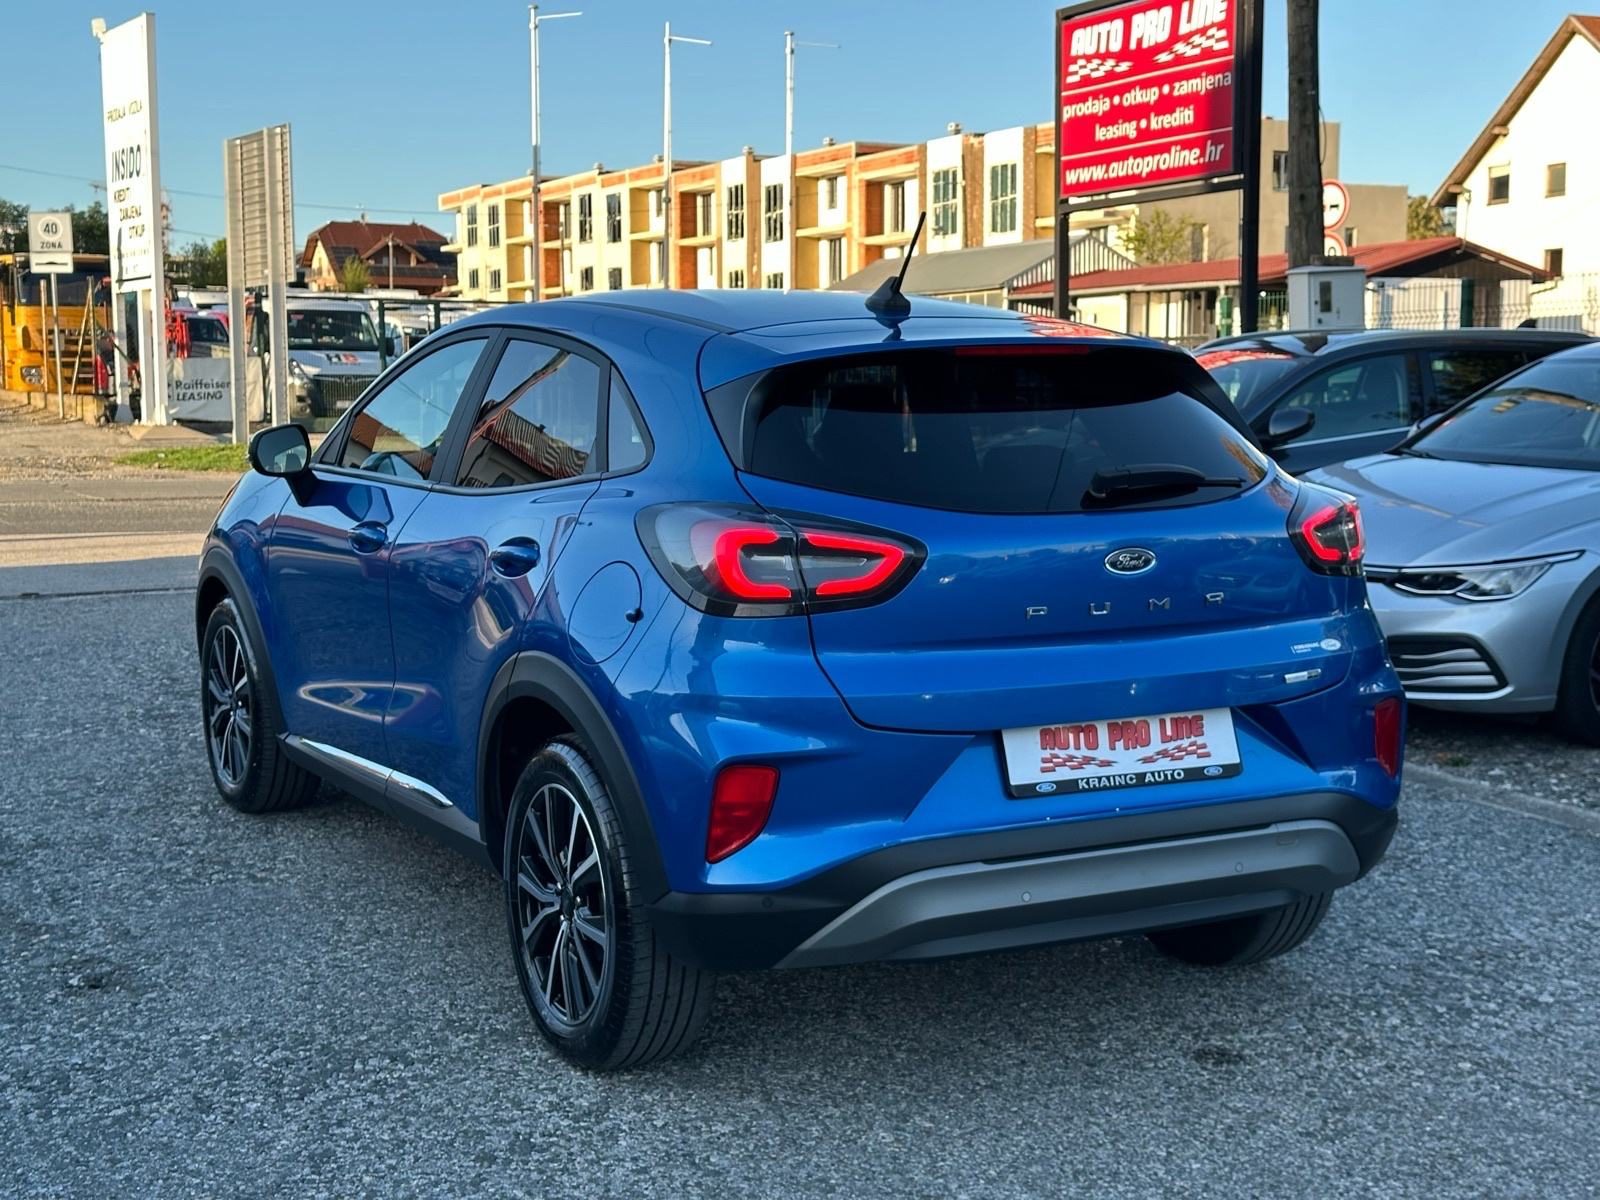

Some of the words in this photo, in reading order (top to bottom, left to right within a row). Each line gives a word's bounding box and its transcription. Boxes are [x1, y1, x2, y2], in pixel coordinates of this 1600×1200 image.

[1070, 18, 1124, 57] AUTO
[1129, 5, 1173, 51] PRO
[1178, 0, 1228, 36] LINE
[1063, 96, 1110, 122] prodaja
[1123, 85, 1159, 107] otkup
[1173, 71, 1232, 95] zamjena
[1095, 120, 1137, 141] leasing
[1150, 105, 1194, 130] krediti
[112, 144, 141, 183] INSIDO
[1065, 139, 1224, 185] www.autoproline.hr
[44, 222, 58, 235] 40
[40, 241, 63, 249] ZONA
[177, 390, 223, 401] LEASING
[1117, 553, 1145, 569] Ford
[1026, 592, 1225, 619] PUMA
[1039, 724, 1099, 751] AUTO
[1107, 719, 1151, 751] PRO
[1159, 715, 1204, 744] LINE
[1078, 774, 1137, 790] KRAINC
[1145, 769, 1185, 783] AUTO
